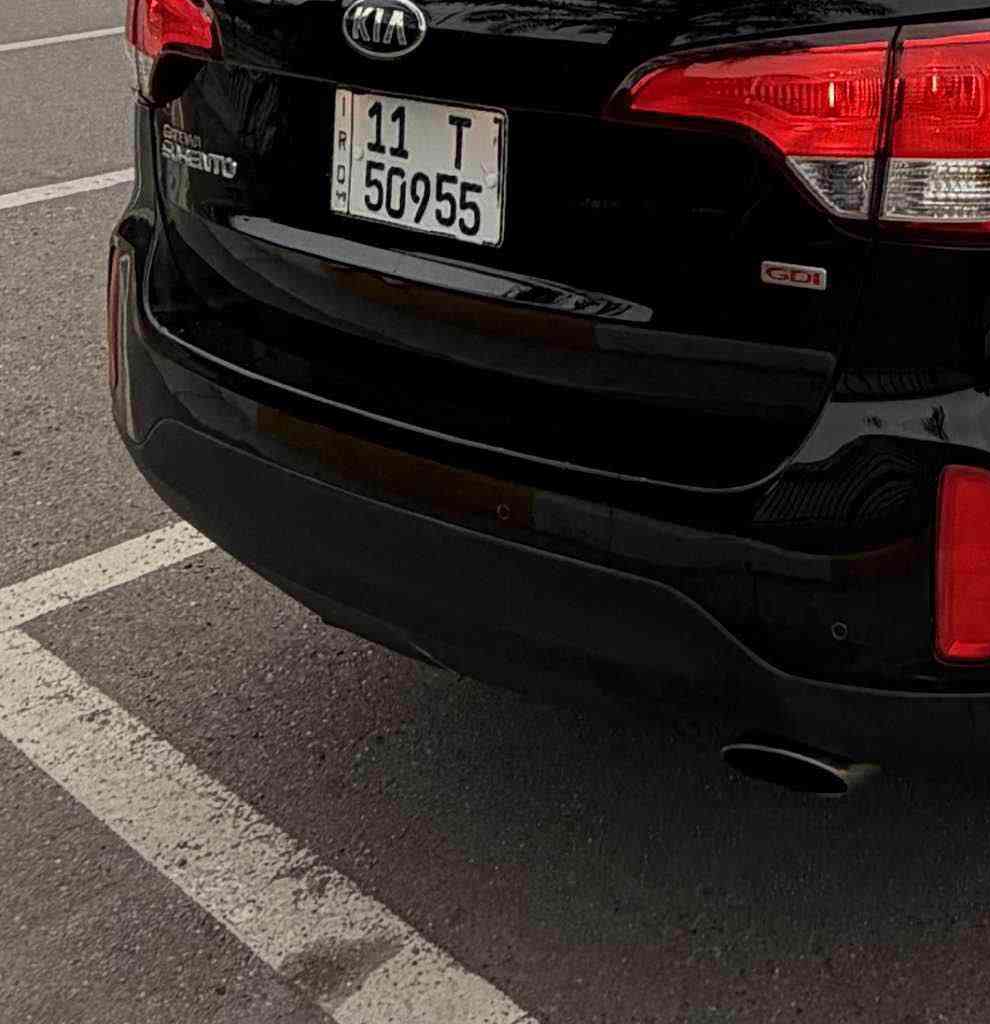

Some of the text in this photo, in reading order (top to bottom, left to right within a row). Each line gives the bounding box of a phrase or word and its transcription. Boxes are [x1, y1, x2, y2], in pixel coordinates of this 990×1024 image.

[352, 6, 407, 46] KIA
[367, 101, 472, 171] 11 T
[364, 160, 482, 237] 50955
[766, 267, 821, 287] GDI
